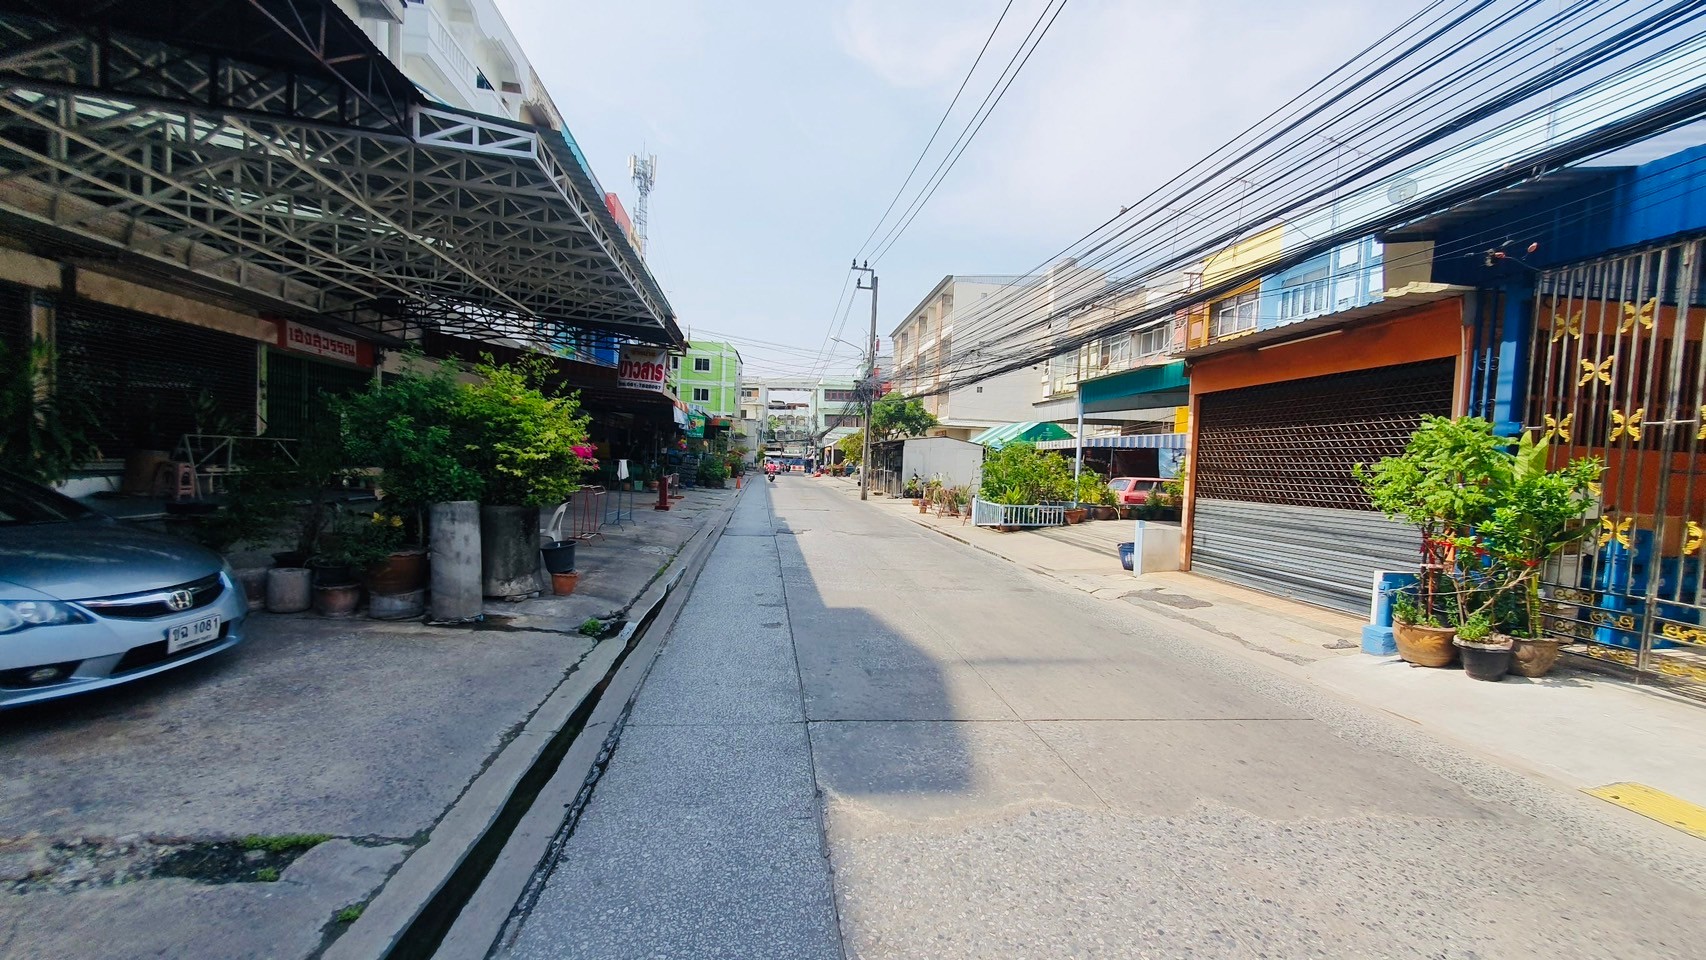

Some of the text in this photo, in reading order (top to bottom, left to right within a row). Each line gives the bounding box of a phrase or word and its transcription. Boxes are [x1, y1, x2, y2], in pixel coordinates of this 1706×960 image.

[619, 353, 664, 381] ข้าวสาร
[194, 618, 218, 634] 1081
